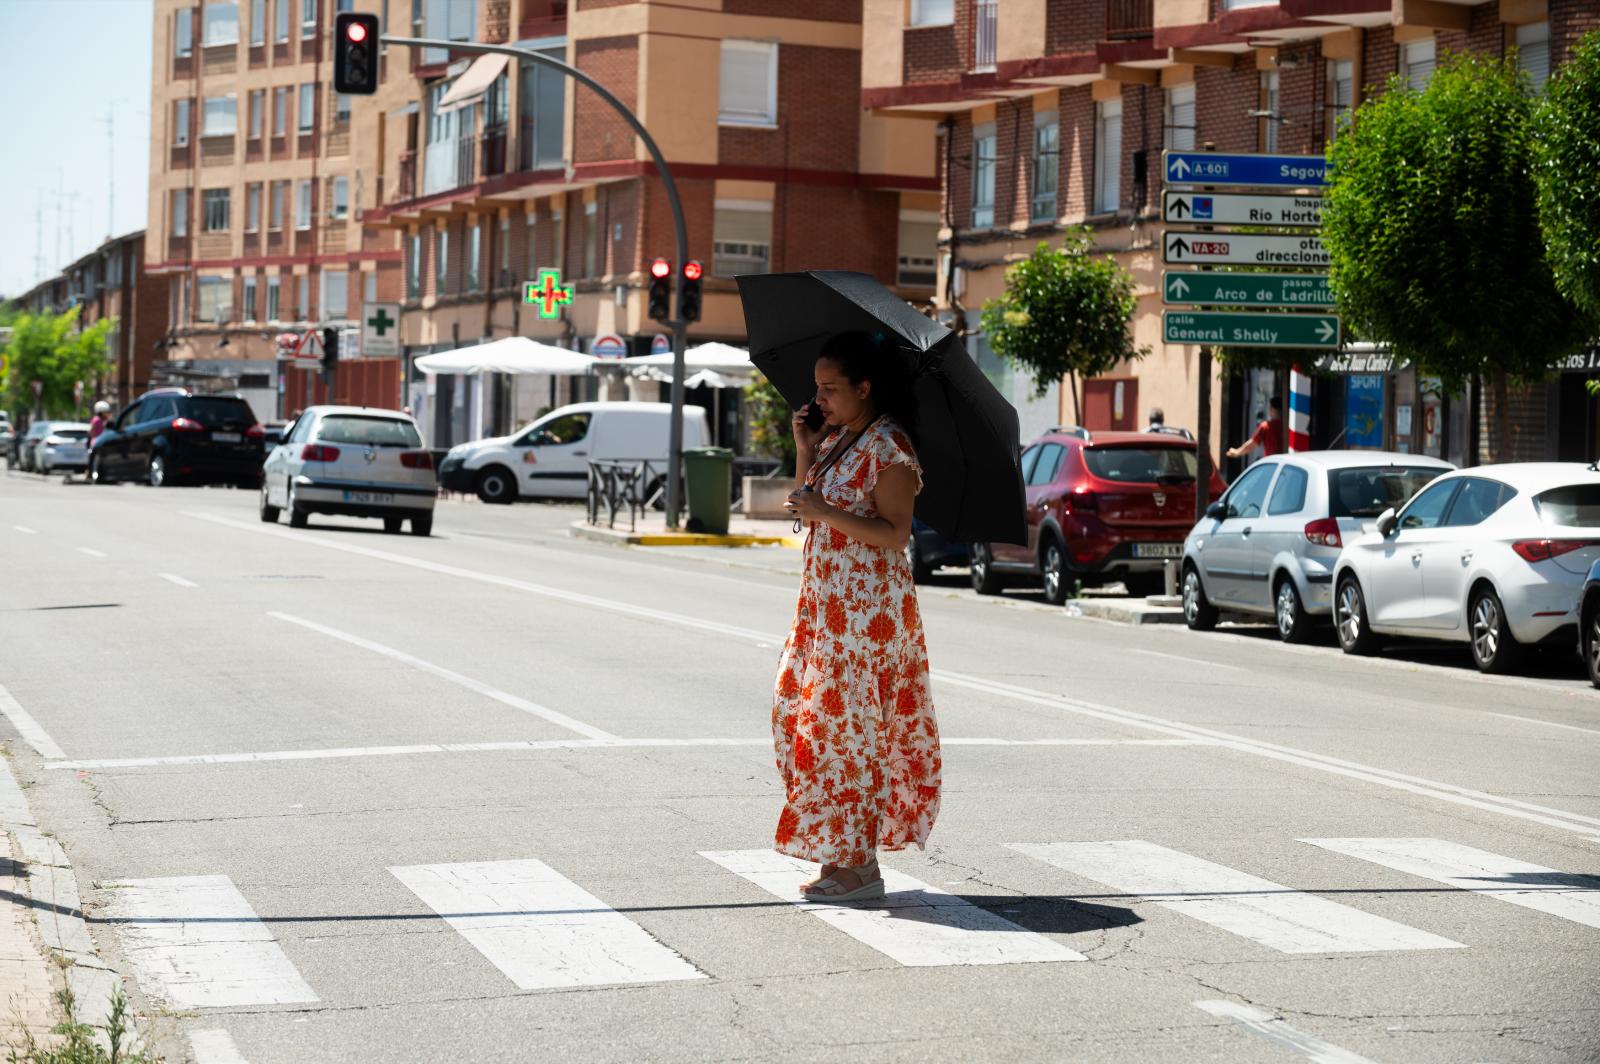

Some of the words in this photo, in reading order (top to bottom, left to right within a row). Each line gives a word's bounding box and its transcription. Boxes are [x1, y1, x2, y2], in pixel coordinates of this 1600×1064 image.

[1194, 164, 1227, 174] A-601
[1280, 164, 1329, 180] Segovi
[1281, 209, 1322, 222] Horte
[1193, 243, 1228, 254] VA-20
[1256, 249, 1330, 262] direccione
[1282, 279, 1313, 288] paseo
[1214, 287, 1248, 300] Arco
[1256, 289, 1273, 301] de
[1282, 289, 1335, 302] Ladrillo
[1168, 315, 1194, 324] calle
[1168, 326, 1224, 340] General
[1233, 328, 1278, 343] Shelly
